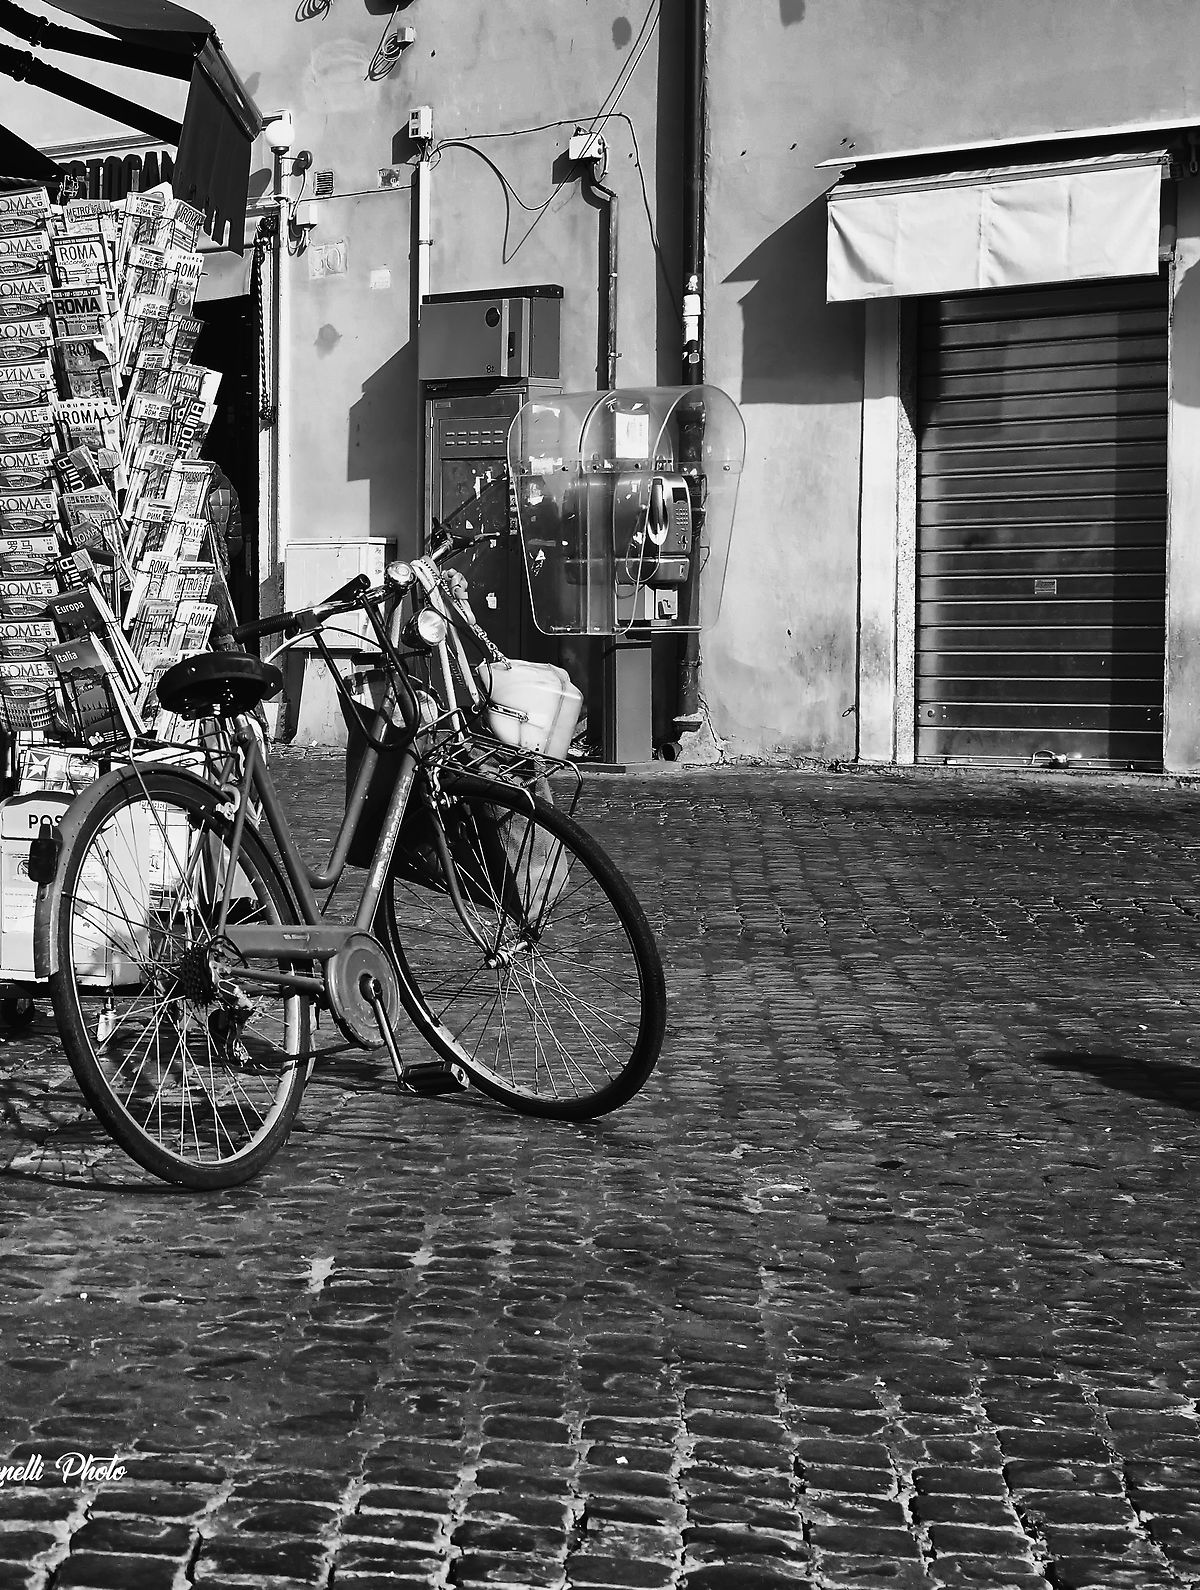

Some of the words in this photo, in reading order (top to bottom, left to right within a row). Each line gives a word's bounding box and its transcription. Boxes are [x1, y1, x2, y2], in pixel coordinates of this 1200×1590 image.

[59, 244, 97, 260] ROMA
[55, 298, 100, 315] ROMA
[180, 319, 201, 333] ROMA
[63, 409, 100, 425] ROMA
[74, 527, 98, 546] ROMA
[55, 600, 85, 615] Europa
[54, 650, 78, 664] Italia
[0, 664, 44, 678] ROME
